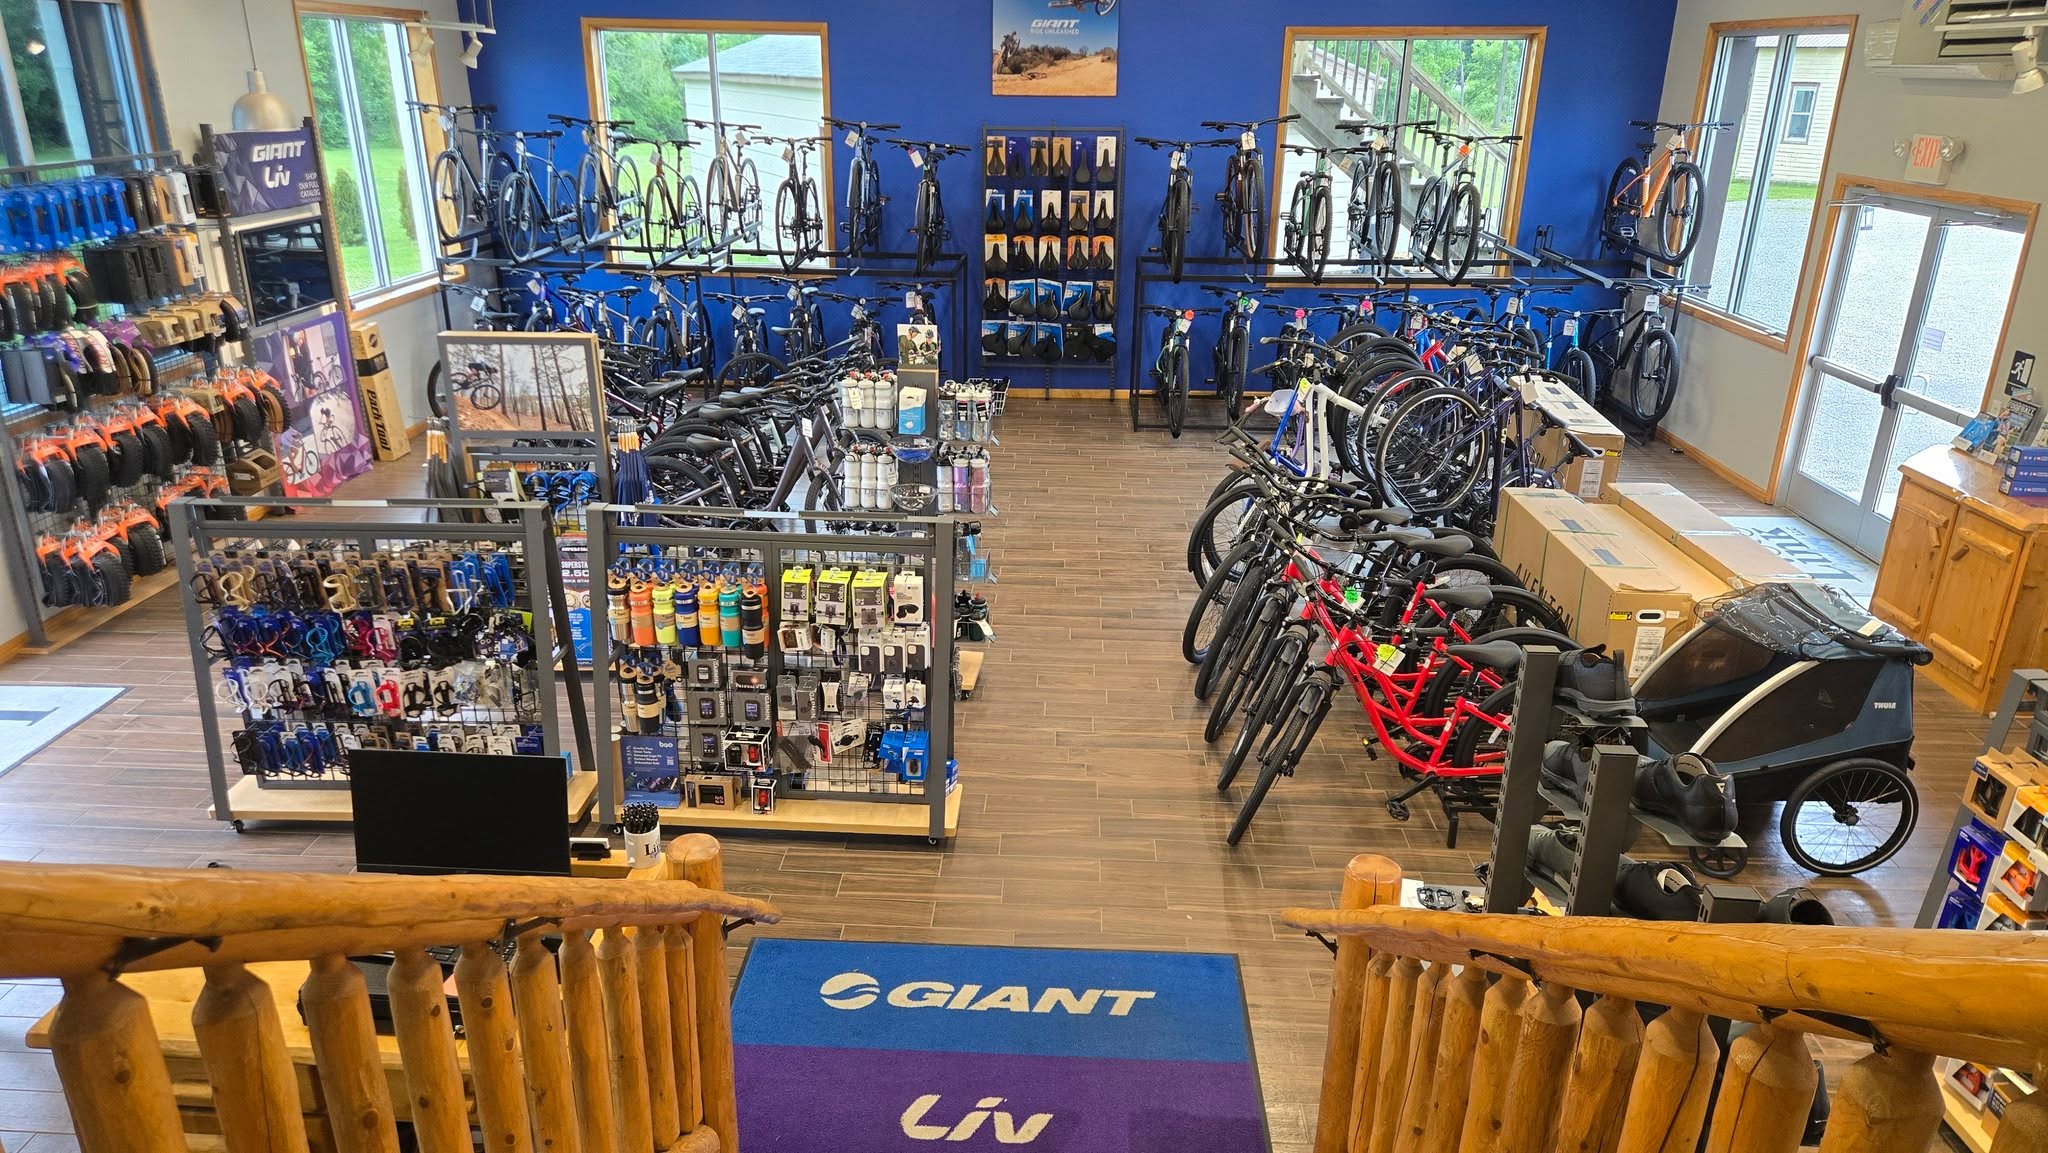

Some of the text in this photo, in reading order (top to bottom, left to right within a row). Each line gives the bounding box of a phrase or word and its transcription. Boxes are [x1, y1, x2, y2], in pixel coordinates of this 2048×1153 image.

[1031, 19, 1080, 28] GIANT
[252, 141, 306, 162] GIANT
[1912, 137, 1941, 168] EXIT
[264, 165, 290, 188] Liv
[304, 172, 317, 180] SHOP
[366, 388, 383, 420] Park
[375, 422, 392, 451] Tool
[718, 691, 727, 719] GARMIN
[764, 694, 772, 721] GARMIN
[809, 691, 818, 720] GARMIN
[886, 981, 1156, 1016] GIANT
[900, 1094, 1054, 1144] Liv
